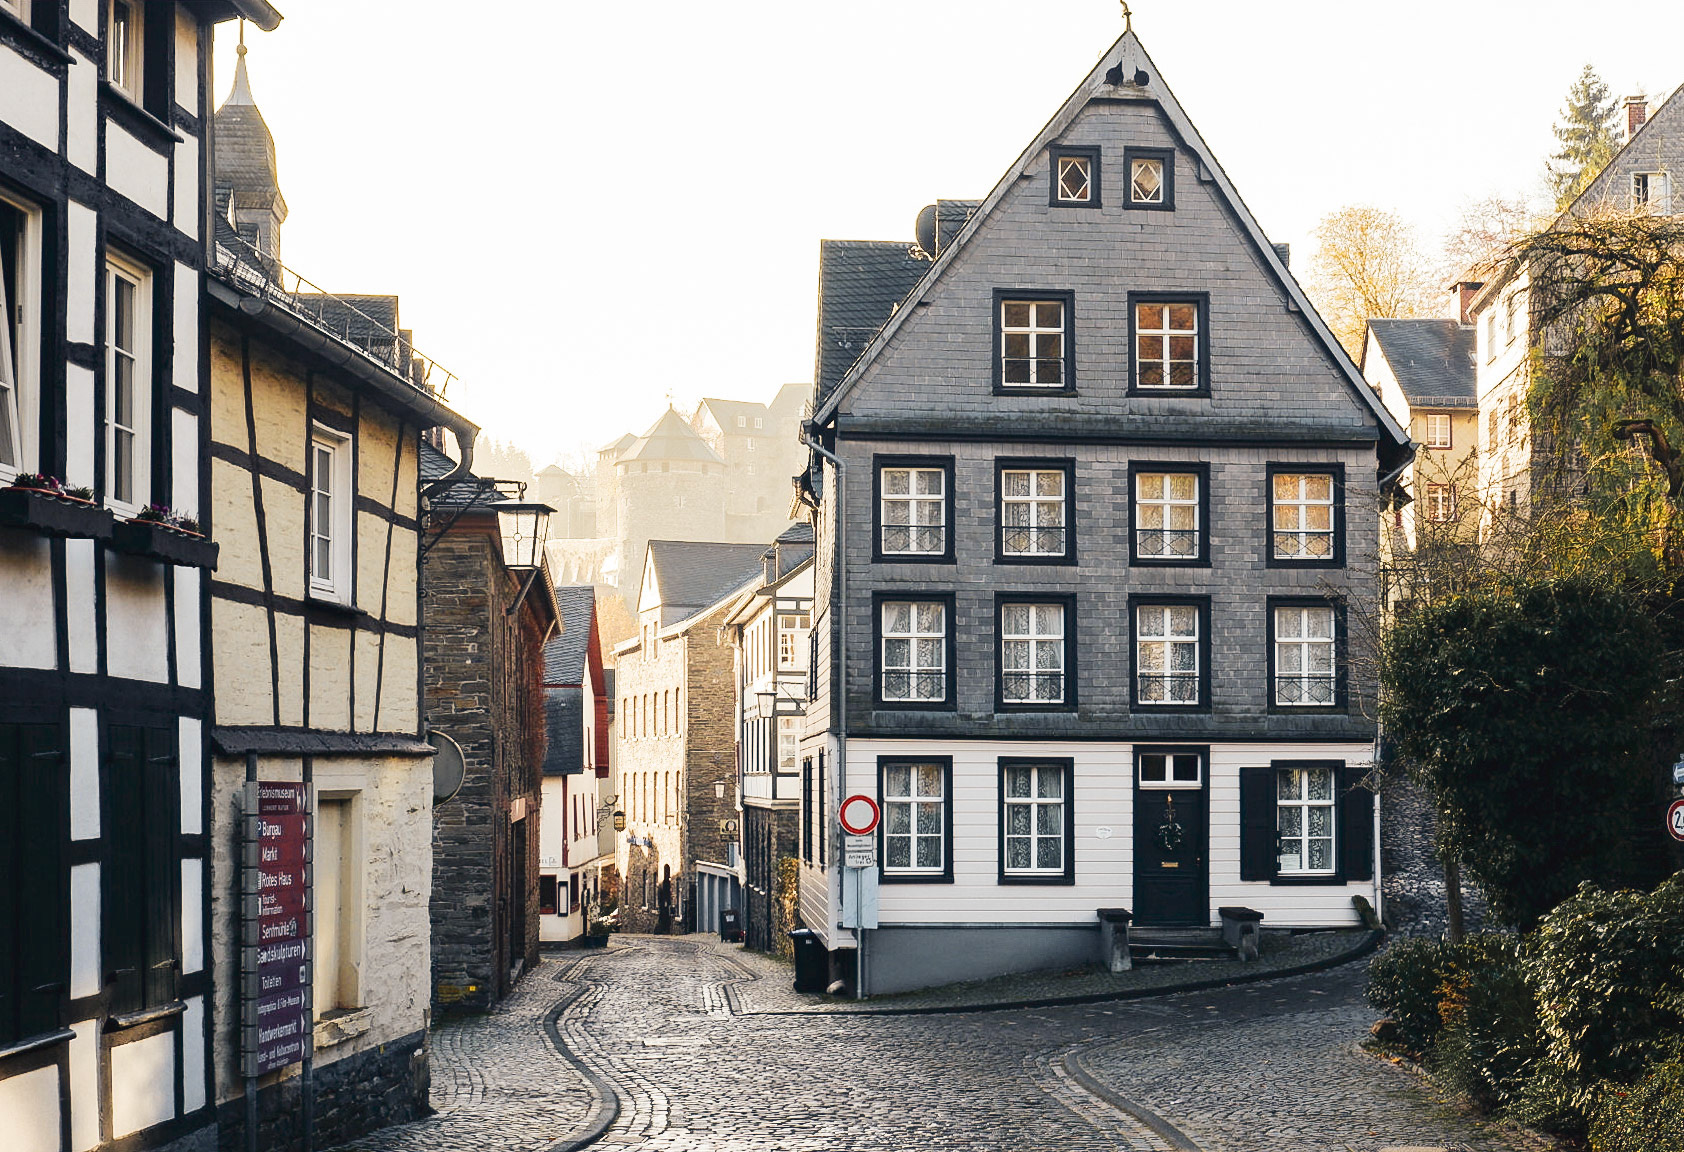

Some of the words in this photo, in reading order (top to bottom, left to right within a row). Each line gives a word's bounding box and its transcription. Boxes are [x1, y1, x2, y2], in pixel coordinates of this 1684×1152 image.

[262, 821, 282, 840] Burgau
[262, 846, 278, 862] Markt
[262, 872, 277, 888] Rotes
[278, 871, 292, 886] Haus
[262, 921, 290, 939] Senfmühle
[257, 944, 301, 964] Sandskulpturen
[258, 1019, 297, 1044] Handwerkermarkt
